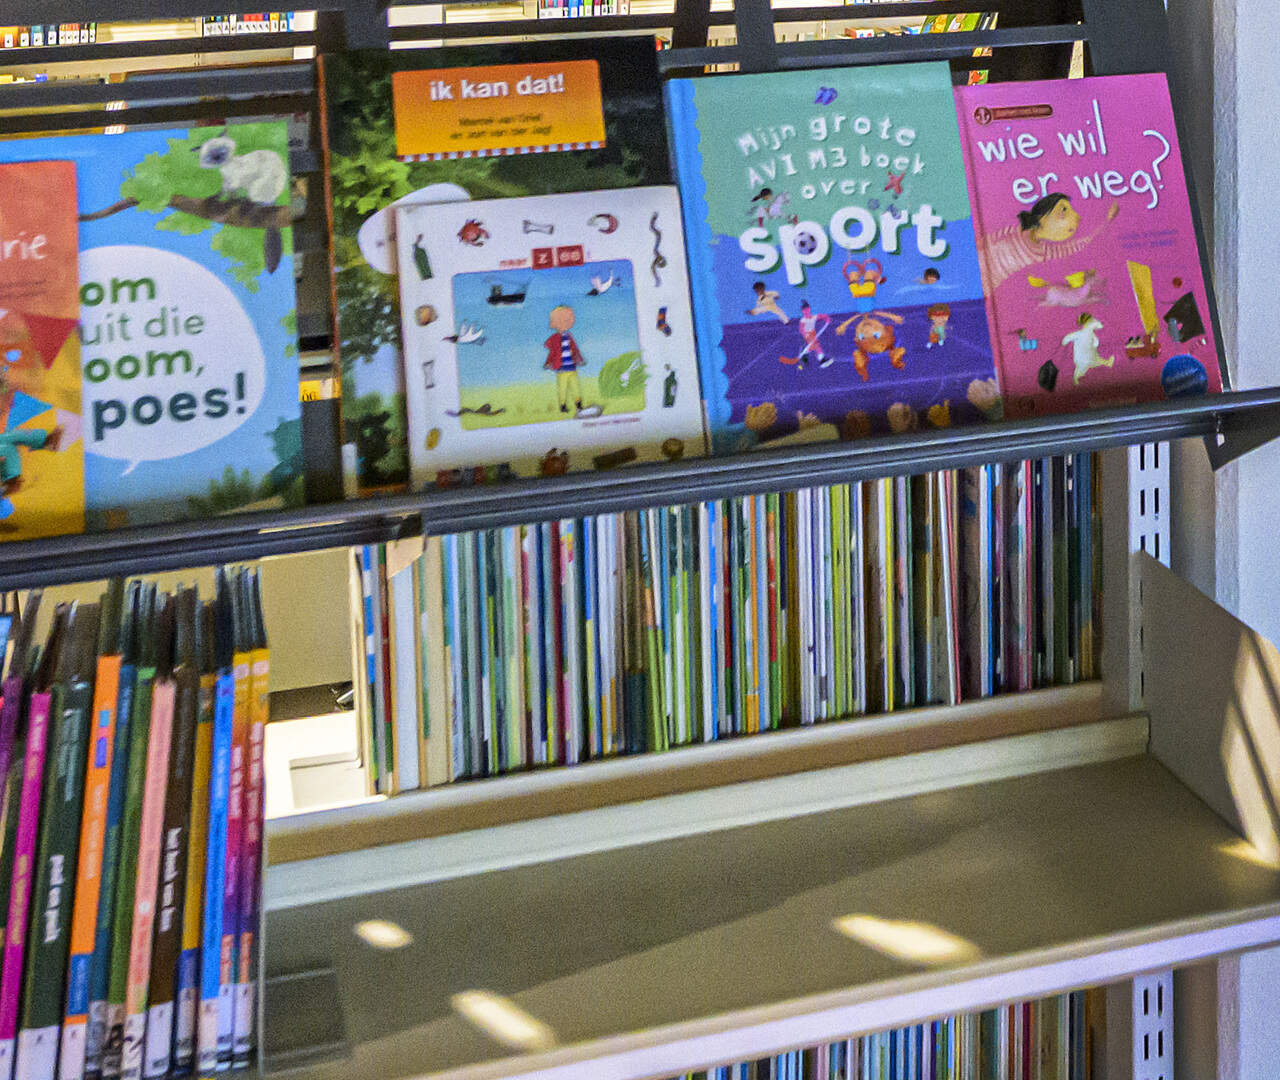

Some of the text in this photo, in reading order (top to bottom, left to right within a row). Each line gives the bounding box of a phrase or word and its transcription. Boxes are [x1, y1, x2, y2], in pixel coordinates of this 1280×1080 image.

[429, 73, 565, 101] ik kan dat!
[737, 114, 917, 157] Mijn grote
[977, 99, 1108, 163] wie wil
[748, 143, 926, 189] AVI M3 boek
[1012, 129, 1171, 210] er weg?
[801, 179, 873, 200] over
[738, 204, 948, 286] sport
[80, 277, 157, 306] om
[80, 306, 205, 346] uit die
[83, 349, 205, 383] oom,
[92, 372, 246, 442] poes!
